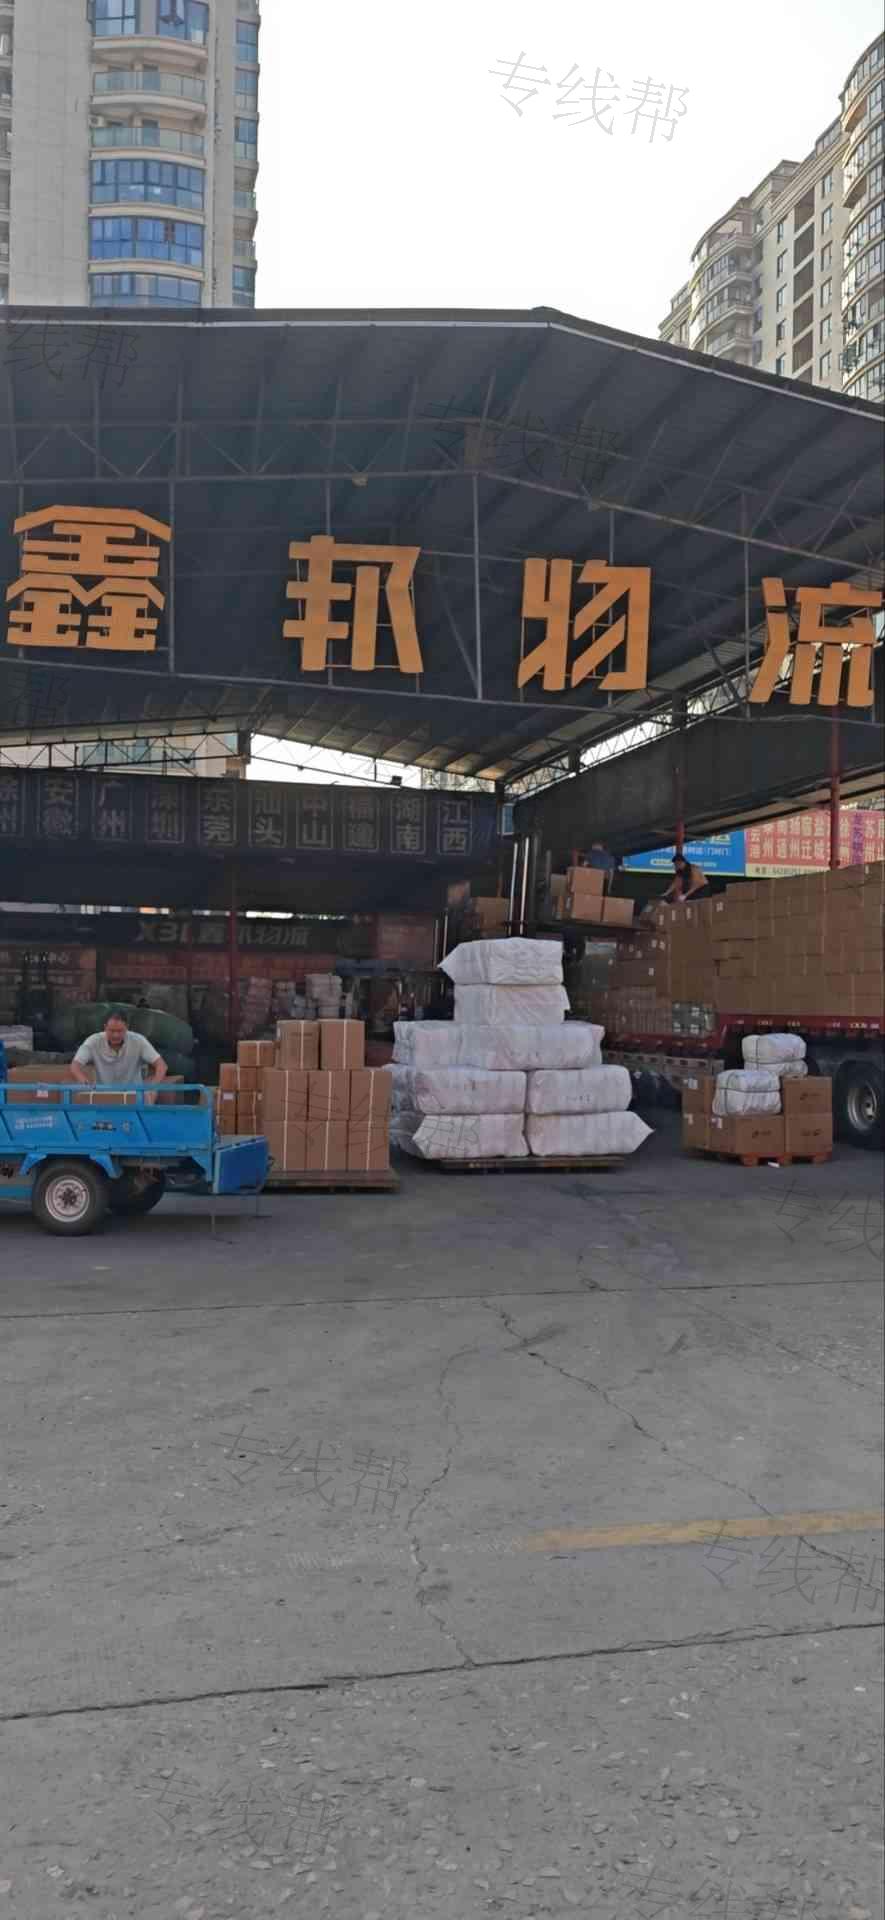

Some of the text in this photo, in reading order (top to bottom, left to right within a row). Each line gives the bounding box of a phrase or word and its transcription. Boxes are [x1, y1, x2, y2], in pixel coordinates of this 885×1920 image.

[6, 504, 883, 707] 鑫邦物流
[204, 788, 234, 842] 东莞
[256, 791, 282, 846] 汕头
[302, 794, 329, 847] 中山
[392, 797, 421, 850] 湖南
[441, 800, 470, 852] 江西
